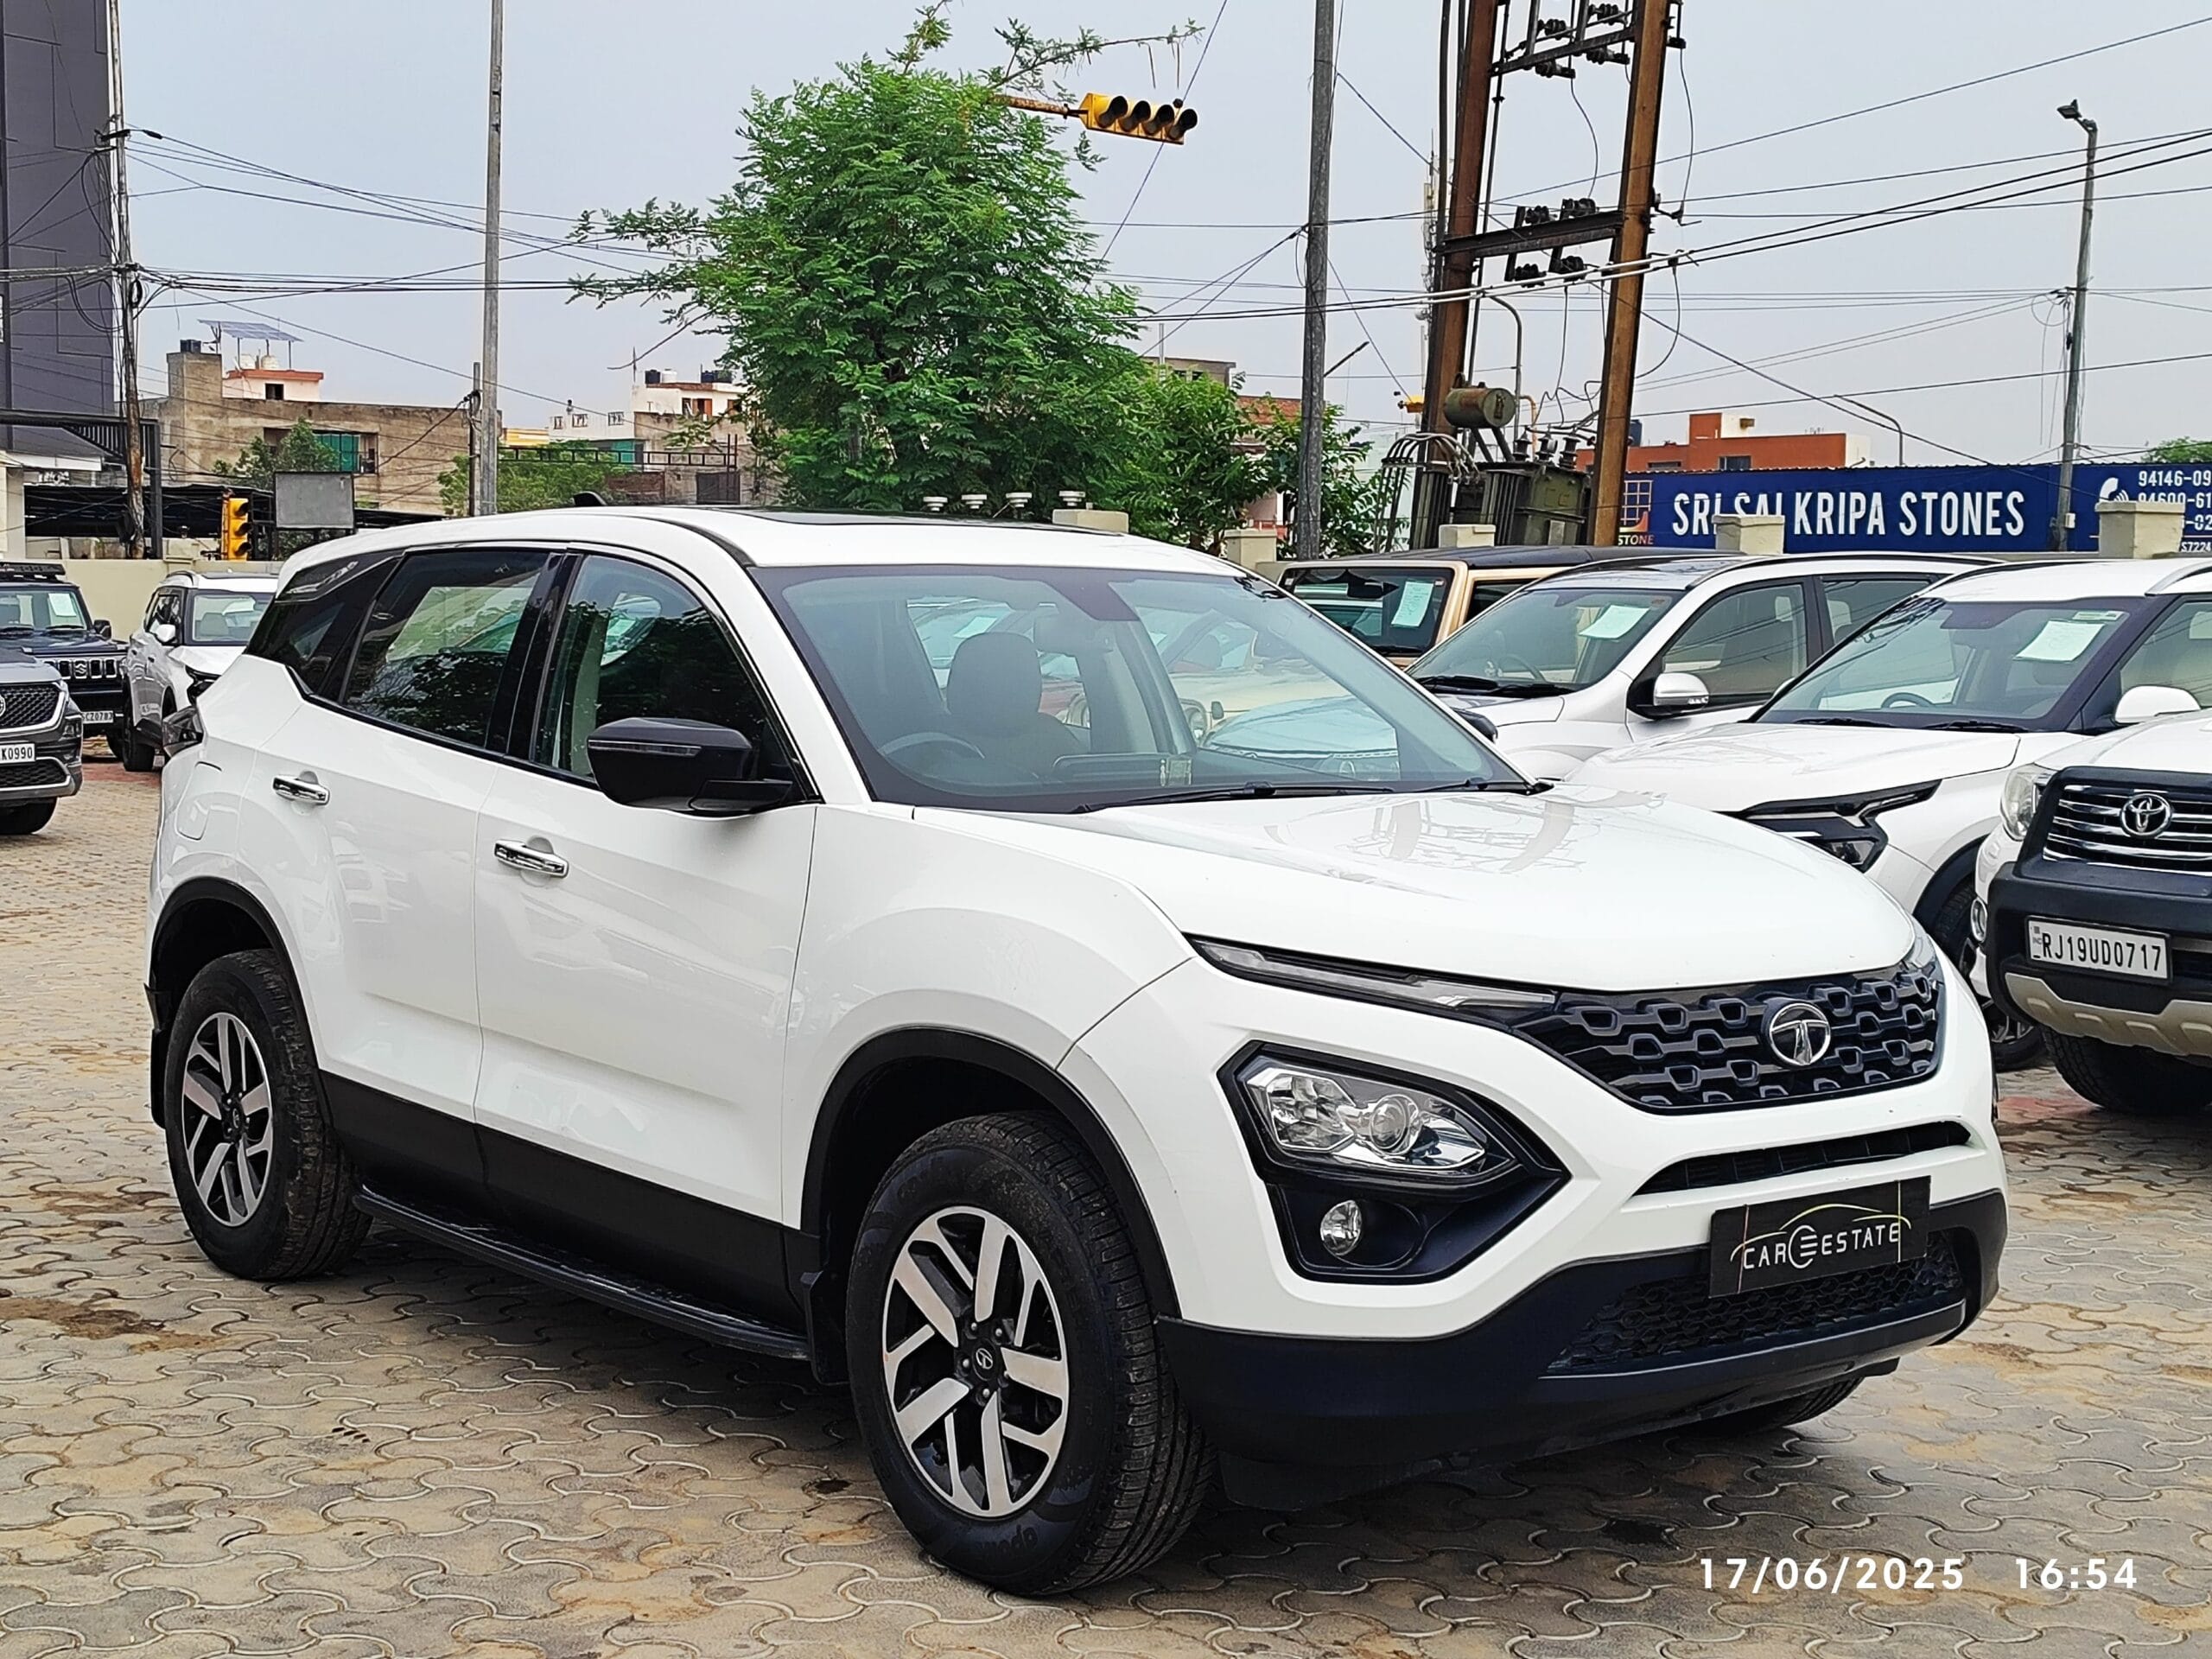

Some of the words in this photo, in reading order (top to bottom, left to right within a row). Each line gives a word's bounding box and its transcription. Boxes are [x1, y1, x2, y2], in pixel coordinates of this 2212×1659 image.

[1672, 493, 1722, 536] SRI
[1794, 492, 1885, 535] KRIPA
[1898, 491, 2024, 537] STONES
[1, 747, 33, 760] K0990
[2042, 932, 2161, 971] RJ19UD0717
